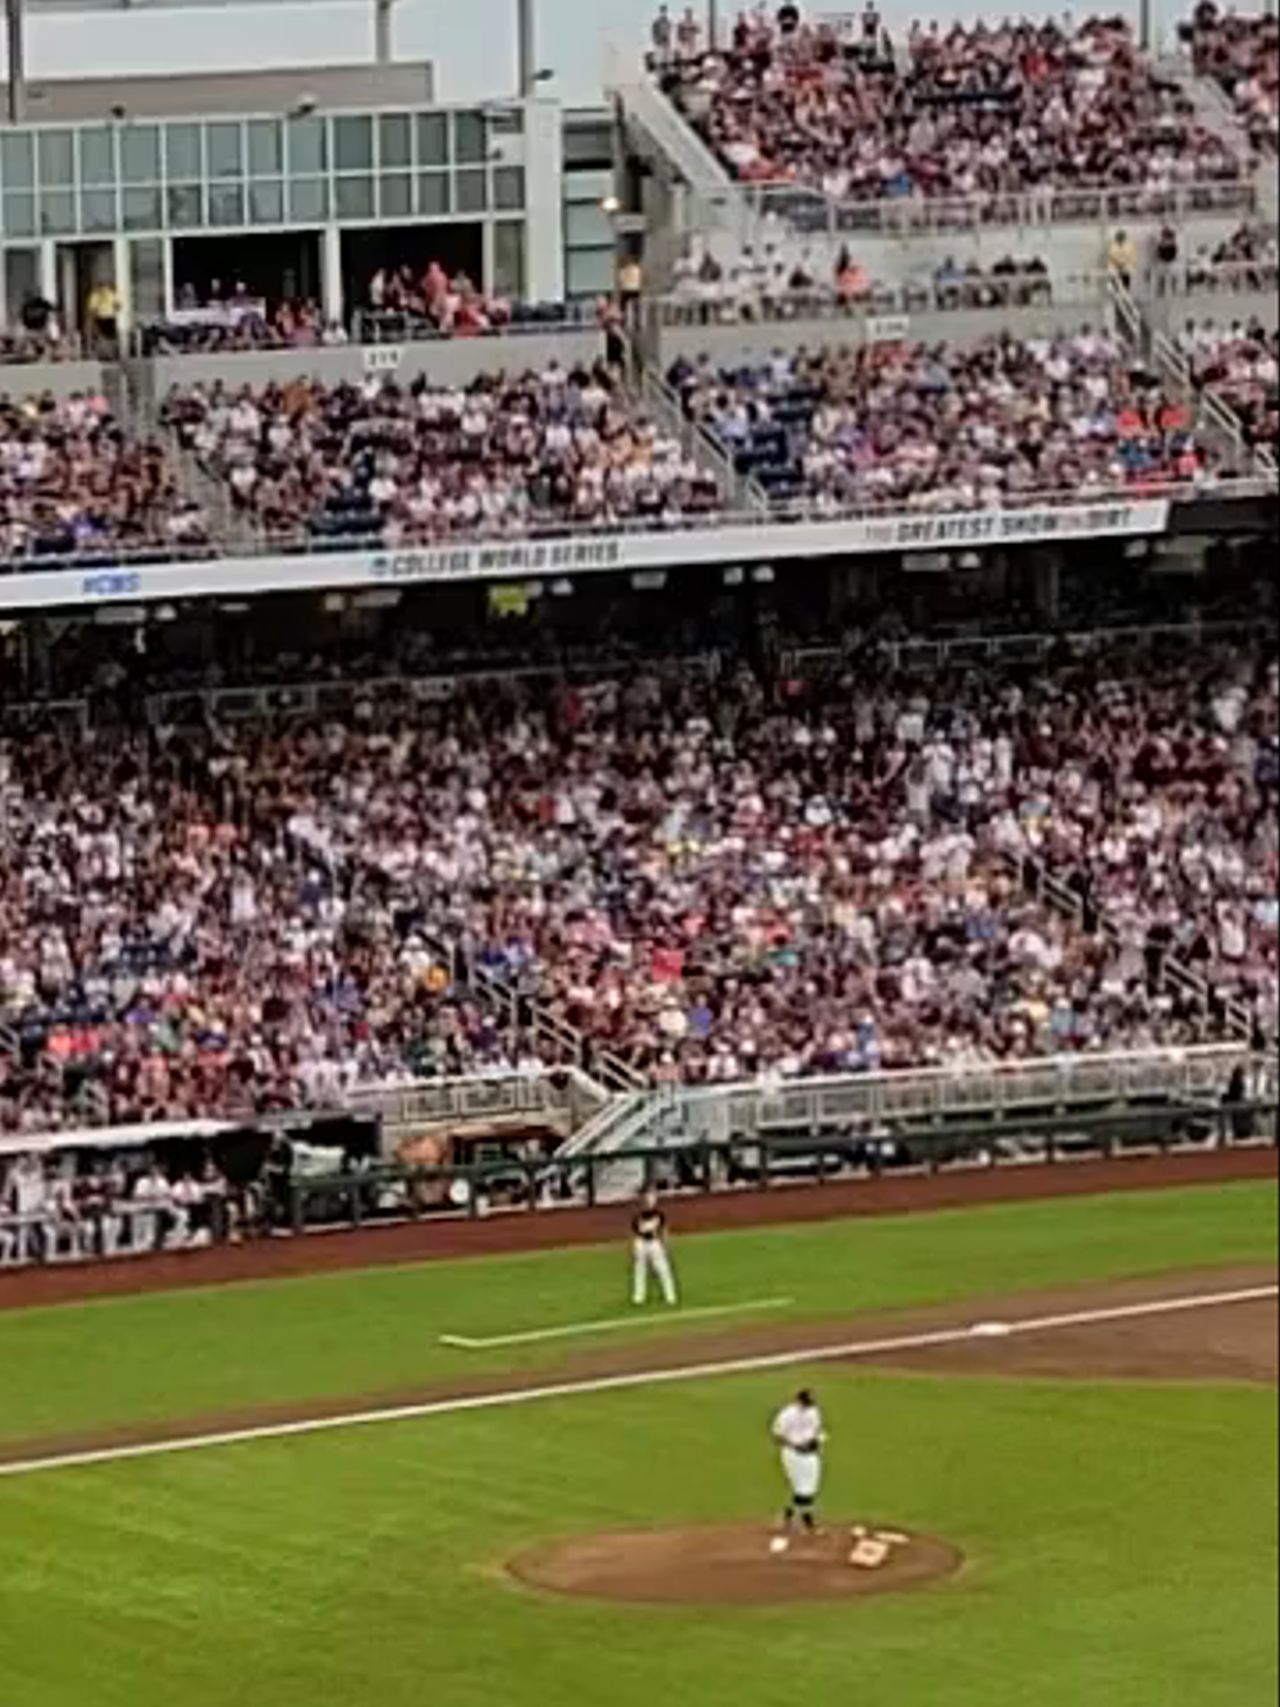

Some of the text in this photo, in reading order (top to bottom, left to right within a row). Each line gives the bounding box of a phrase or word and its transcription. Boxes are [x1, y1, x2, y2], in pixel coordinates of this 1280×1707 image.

[897, 514, 993, 542] GREATEST
[1000, 511, 1059, 535] SHOW
[391, 540, 620, 576] COLLEGE WORLD SERIES
